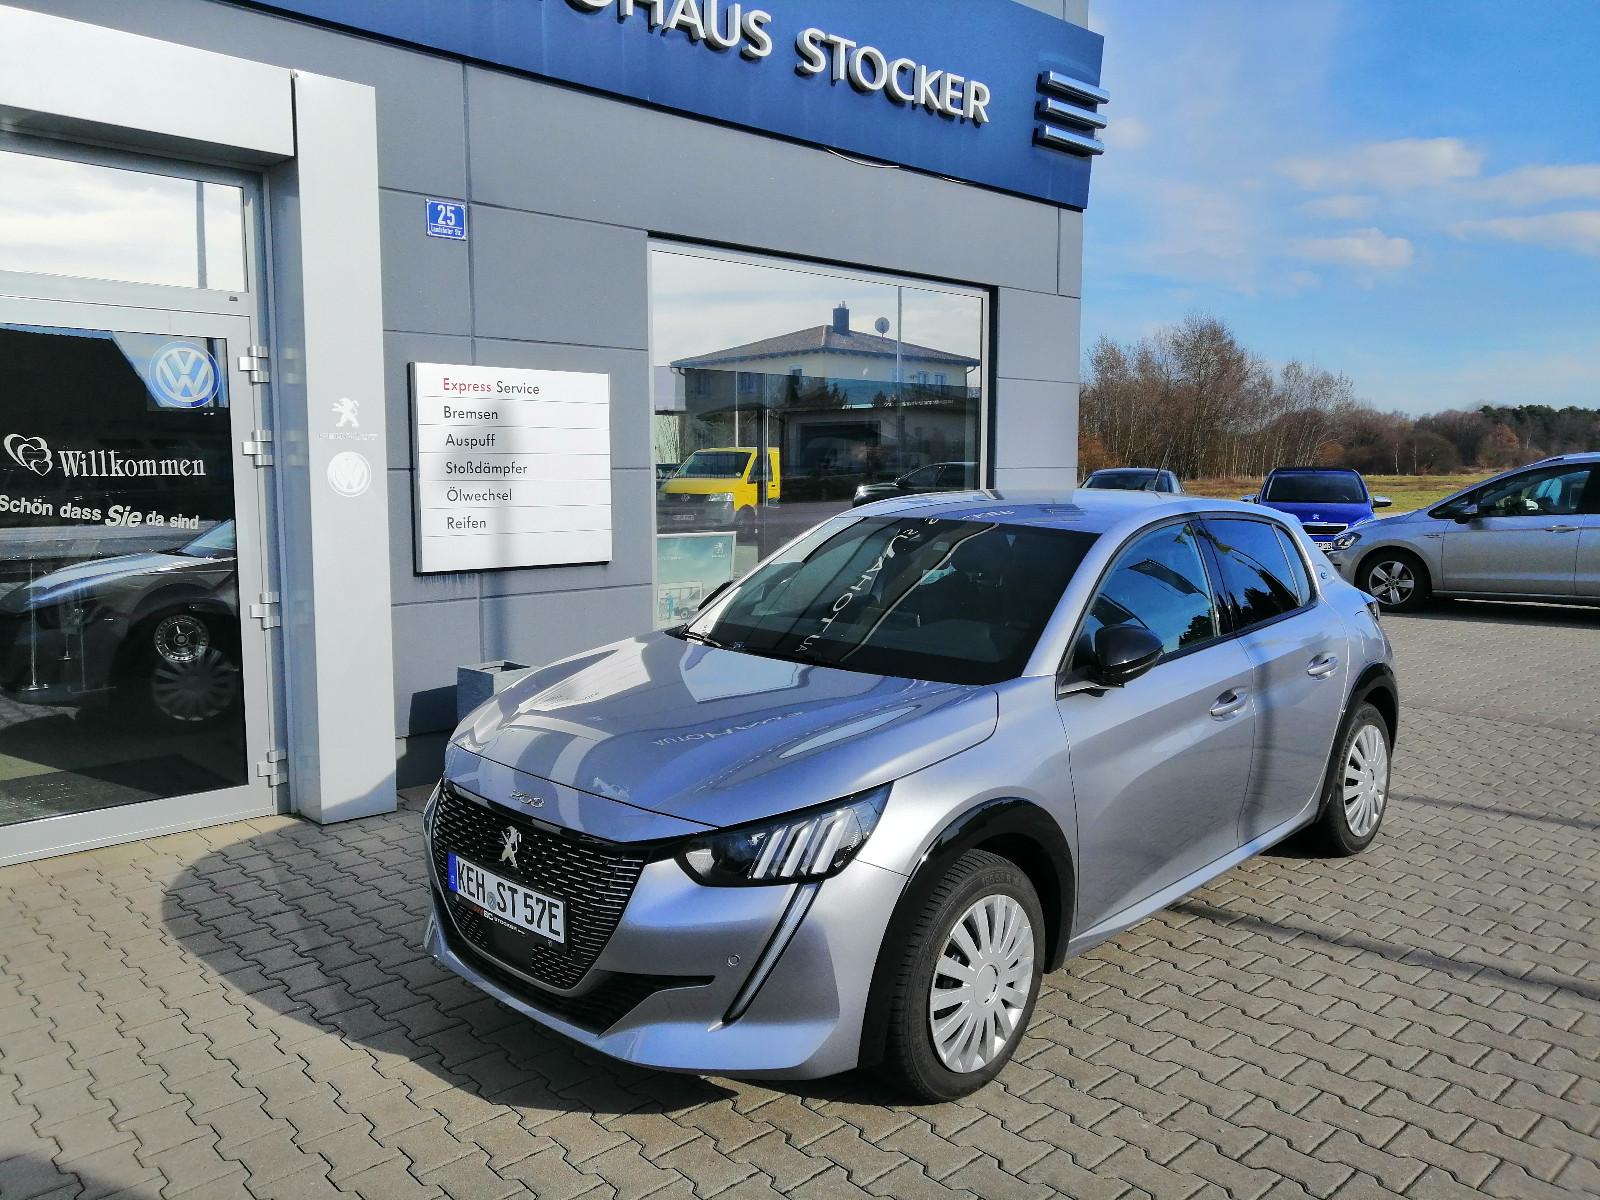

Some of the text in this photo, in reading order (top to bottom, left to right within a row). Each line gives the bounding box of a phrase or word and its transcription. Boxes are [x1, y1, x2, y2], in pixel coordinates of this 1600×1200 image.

[796, 27, 991, 124] STOCKER
[437, 204, 455, 226] 25
[443, 377, 540, 395] Express Service
[443, 405, 498, 420] Bremsen
[445, 433, 496, 449] Auspuff
[57, 449, 207, 478] Willkommen
[445, 460, 528, 477] Stoßdämpfer
[446, 486, 512, 502] Ölwechsel
[0, 494, 200, 530] Schön dass Sie da sind
[447, 516, 487, 529] Reifen
[457, 860, 486, 904] KEH
[496, 881, 518, 919] ST
[523, 892, 561, 937] 57E
